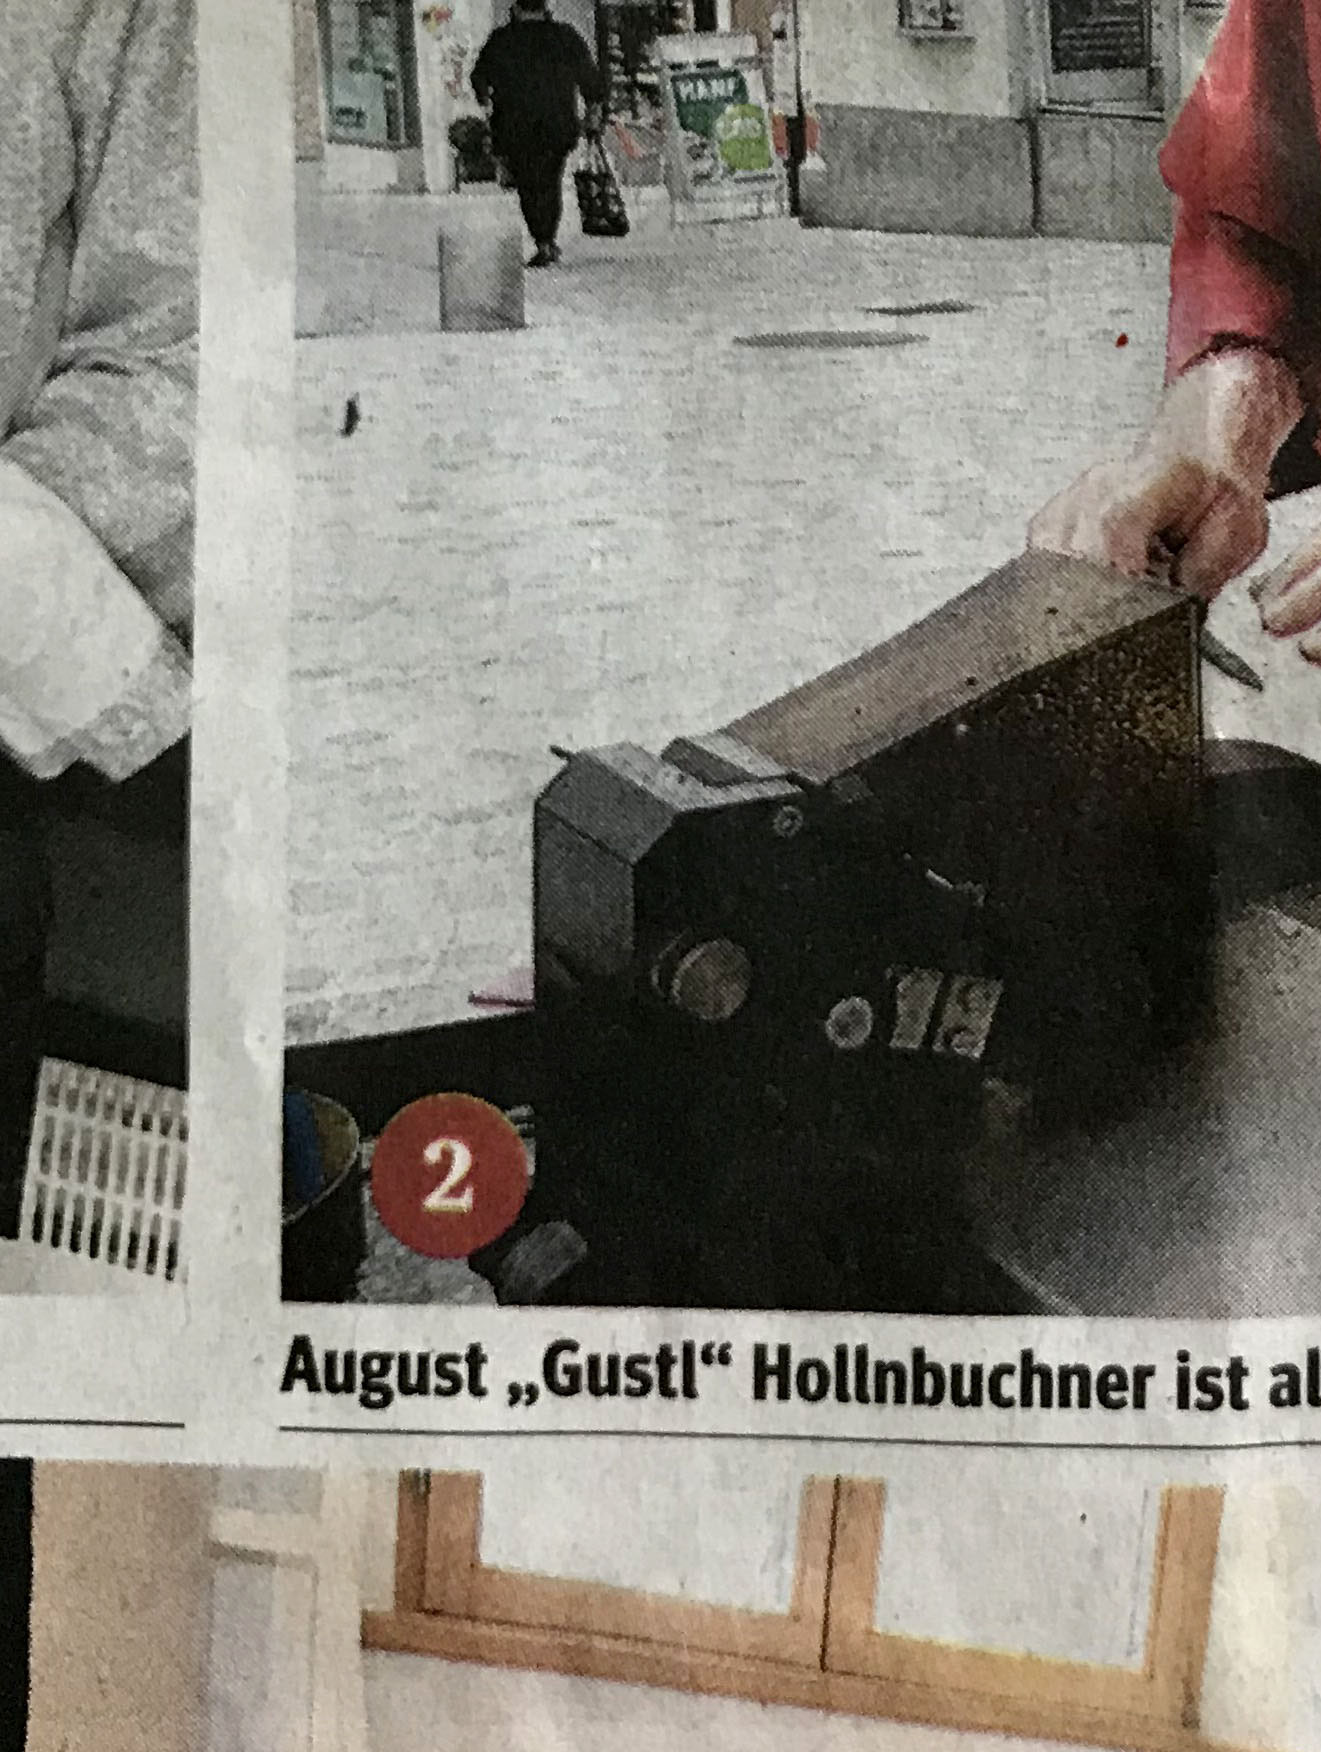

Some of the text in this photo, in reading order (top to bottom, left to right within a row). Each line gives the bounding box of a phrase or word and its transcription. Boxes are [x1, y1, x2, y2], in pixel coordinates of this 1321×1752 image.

[421, 1137, 475, 1215] 2
[279, 1334, 489, 1411] August
[507, 1338, 733, 1409] „Gustl“
[751, 1342, 1157, 1411] Hollnbuchner
[1176, 1349, 1250, 1413] ist
